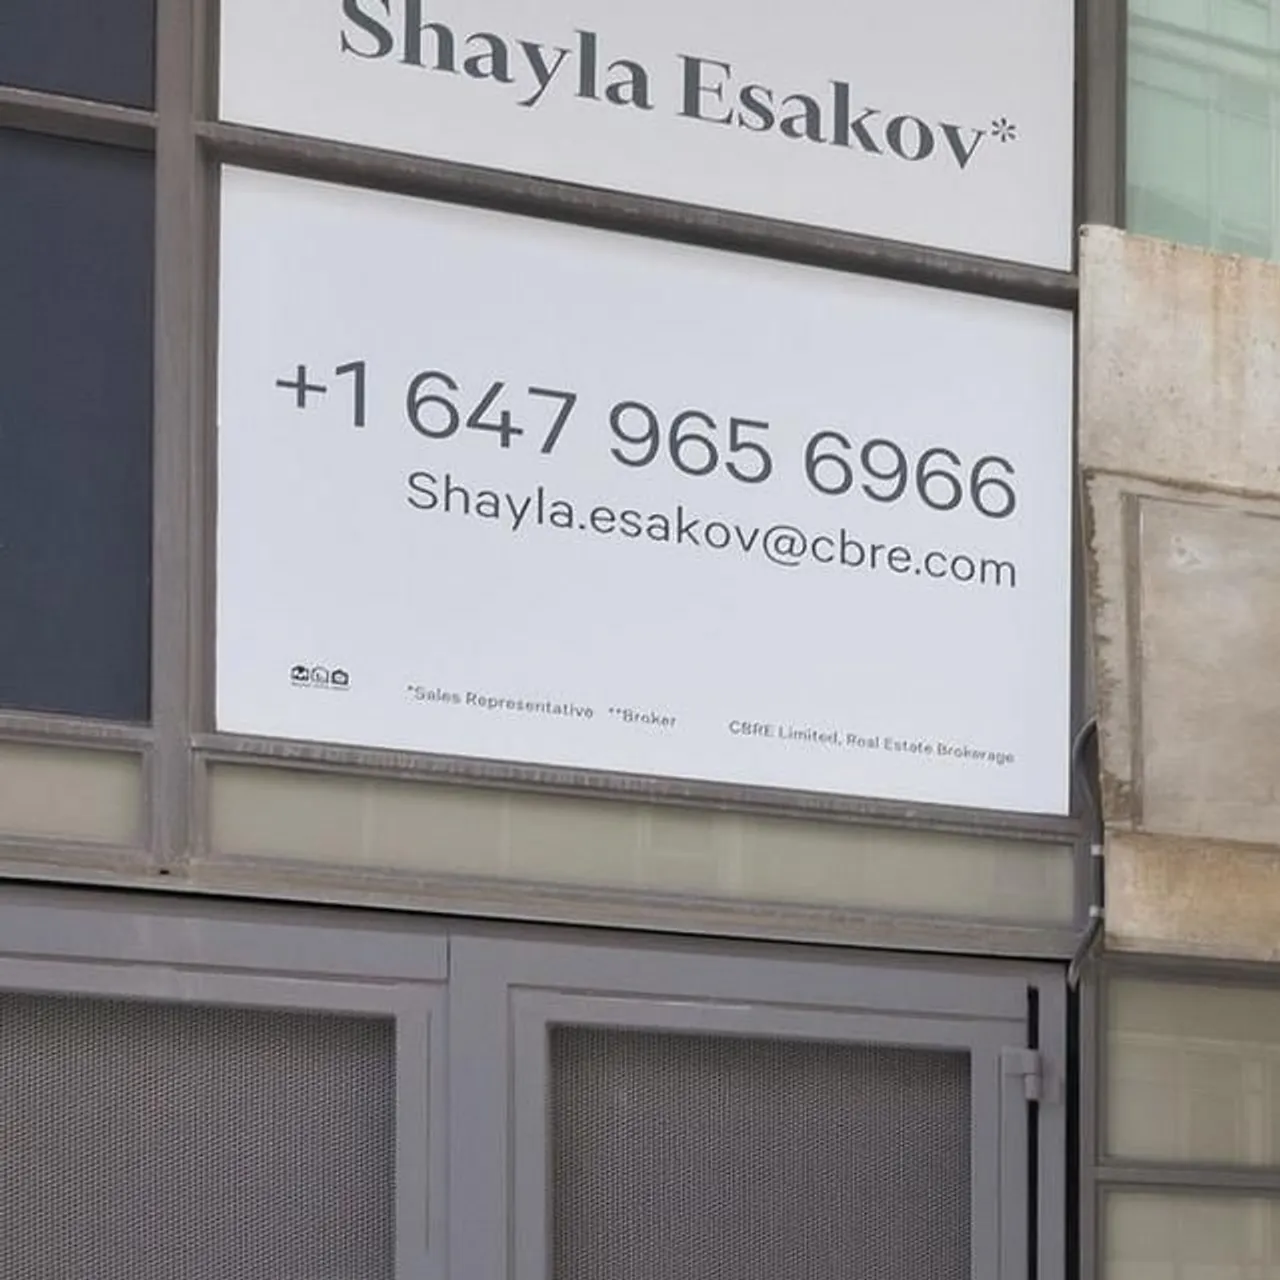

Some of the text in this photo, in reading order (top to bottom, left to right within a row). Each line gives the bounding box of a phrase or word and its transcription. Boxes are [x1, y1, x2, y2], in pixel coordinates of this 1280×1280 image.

[341, 0, 655, 110] Shayla
[275, 360, 1017, 519] +1 647 965 6966
[407, 471, 1017, 588] Shayla.esakov@cbre.com
[465, 692, 595, 719] Representative
[728, 720, 774, 738] CBRE
[846, 733, 879, 749] Real
[884, 738, 933, 755] Estate
[937, 742, 1016, 765] Brokerage
